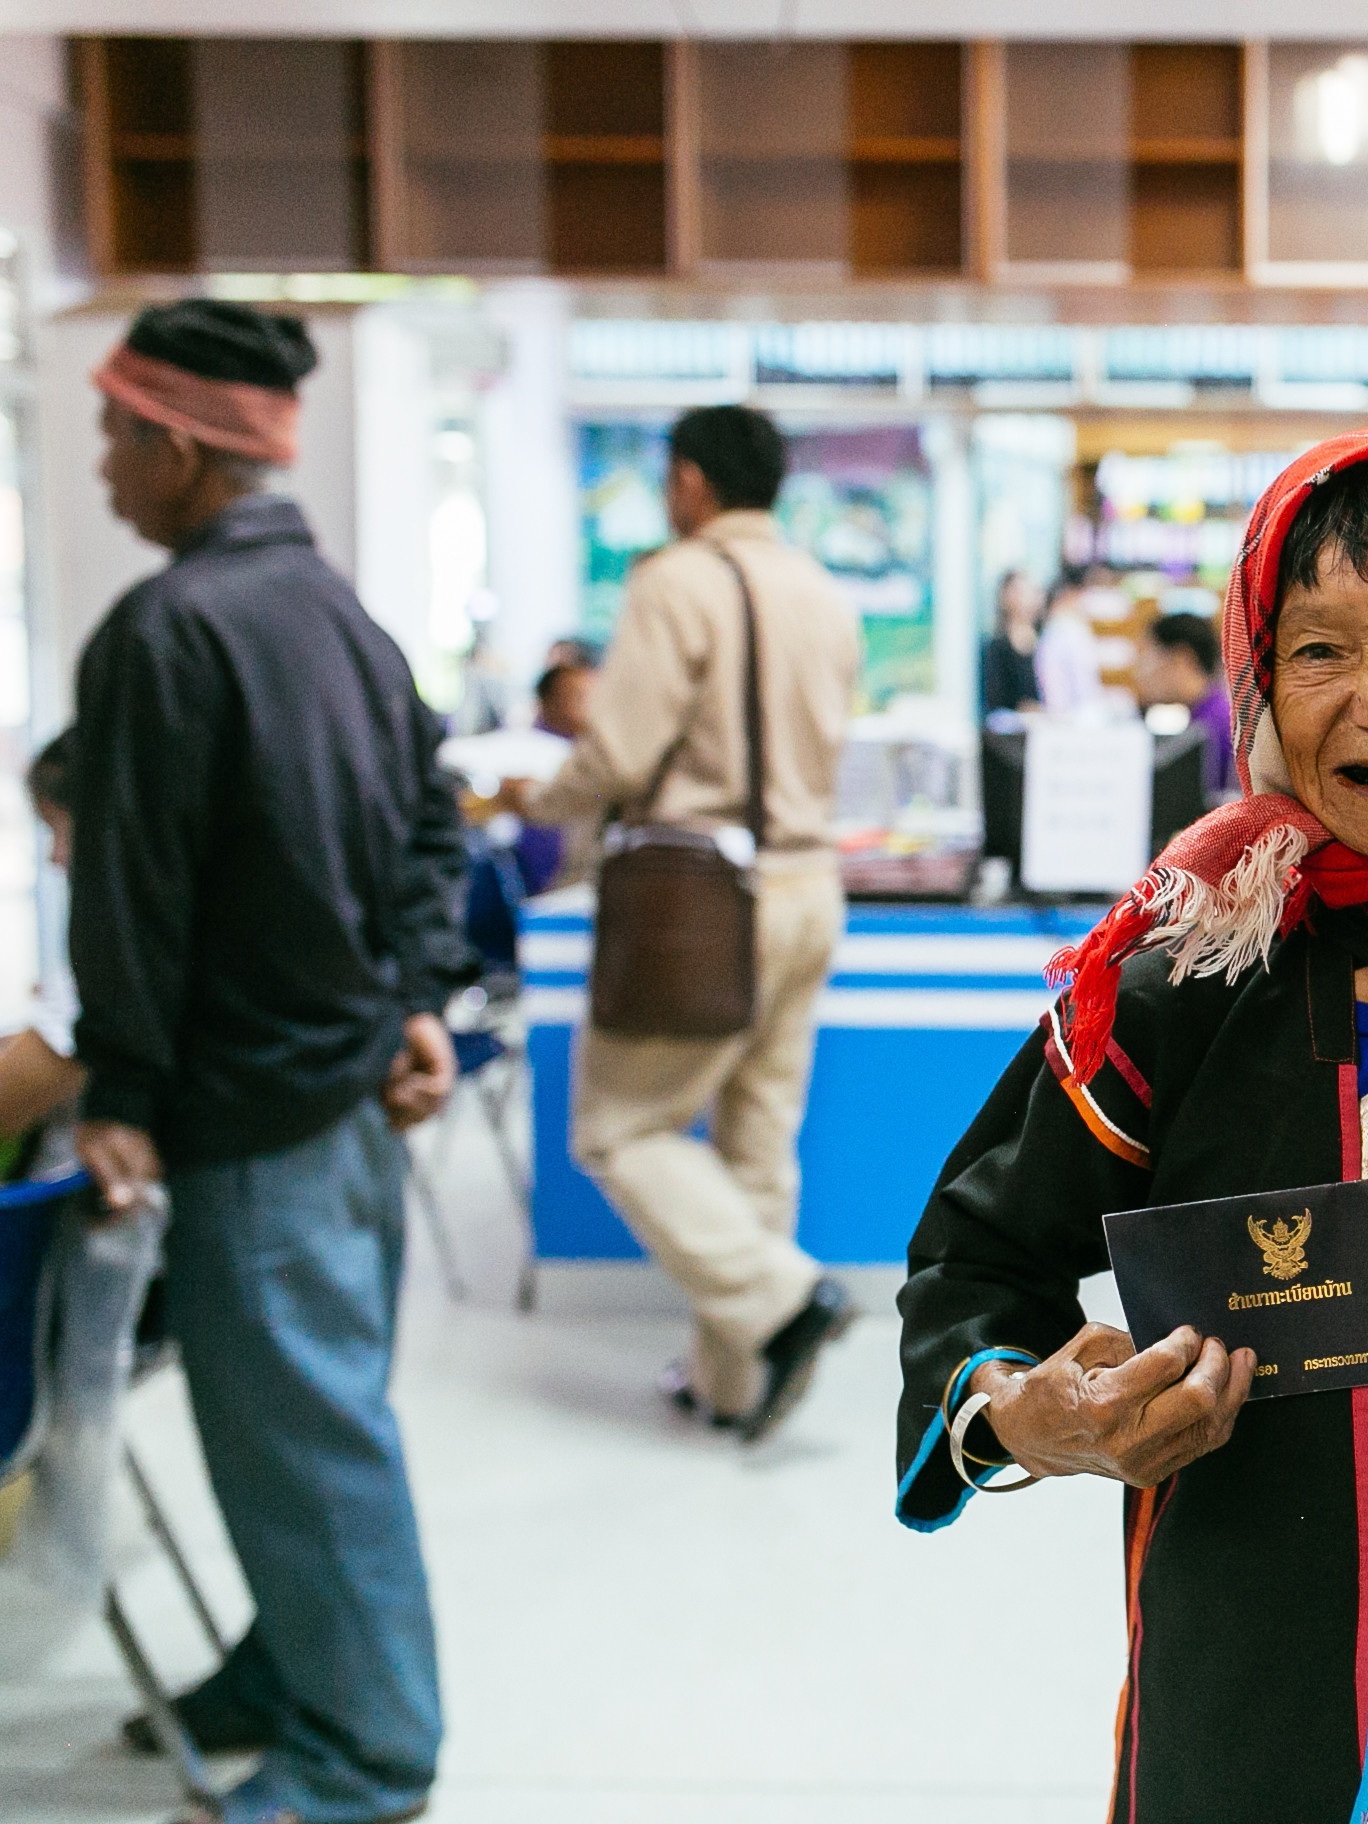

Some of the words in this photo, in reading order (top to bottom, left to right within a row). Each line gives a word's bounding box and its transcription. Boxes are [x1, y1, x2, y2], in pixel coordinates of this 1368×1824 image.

[1228, 1279, 1353, 1311] สำเนาทะเบียนบ้าน
